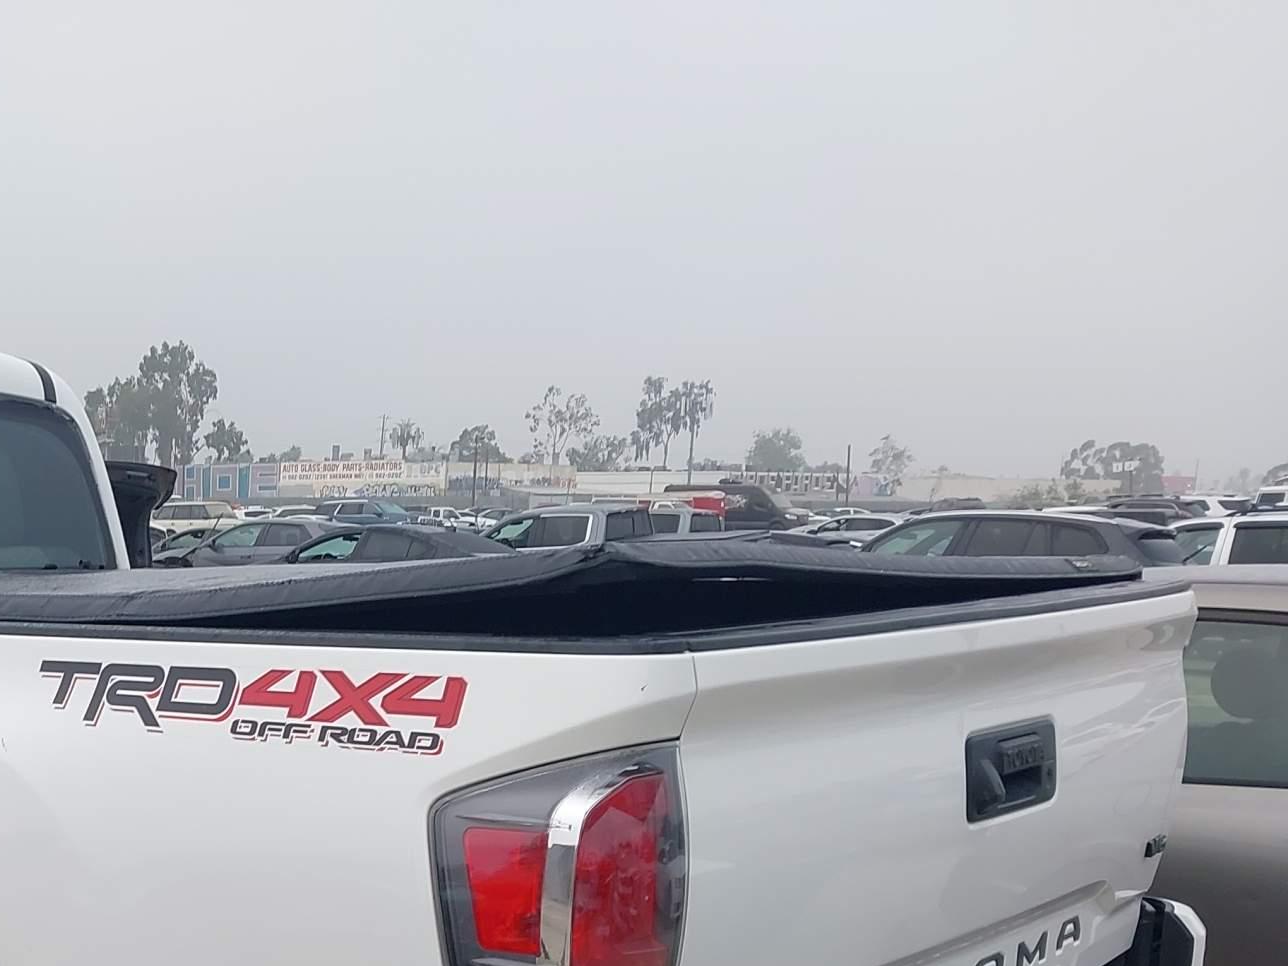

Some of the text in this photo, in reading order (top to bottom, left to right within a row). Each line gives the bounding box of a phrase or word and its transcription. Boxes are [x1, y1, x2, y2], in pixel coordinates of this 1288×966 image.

[282, 463, 298, 473] AUTO
[230, 718, 444, 755] OFF ROAD
